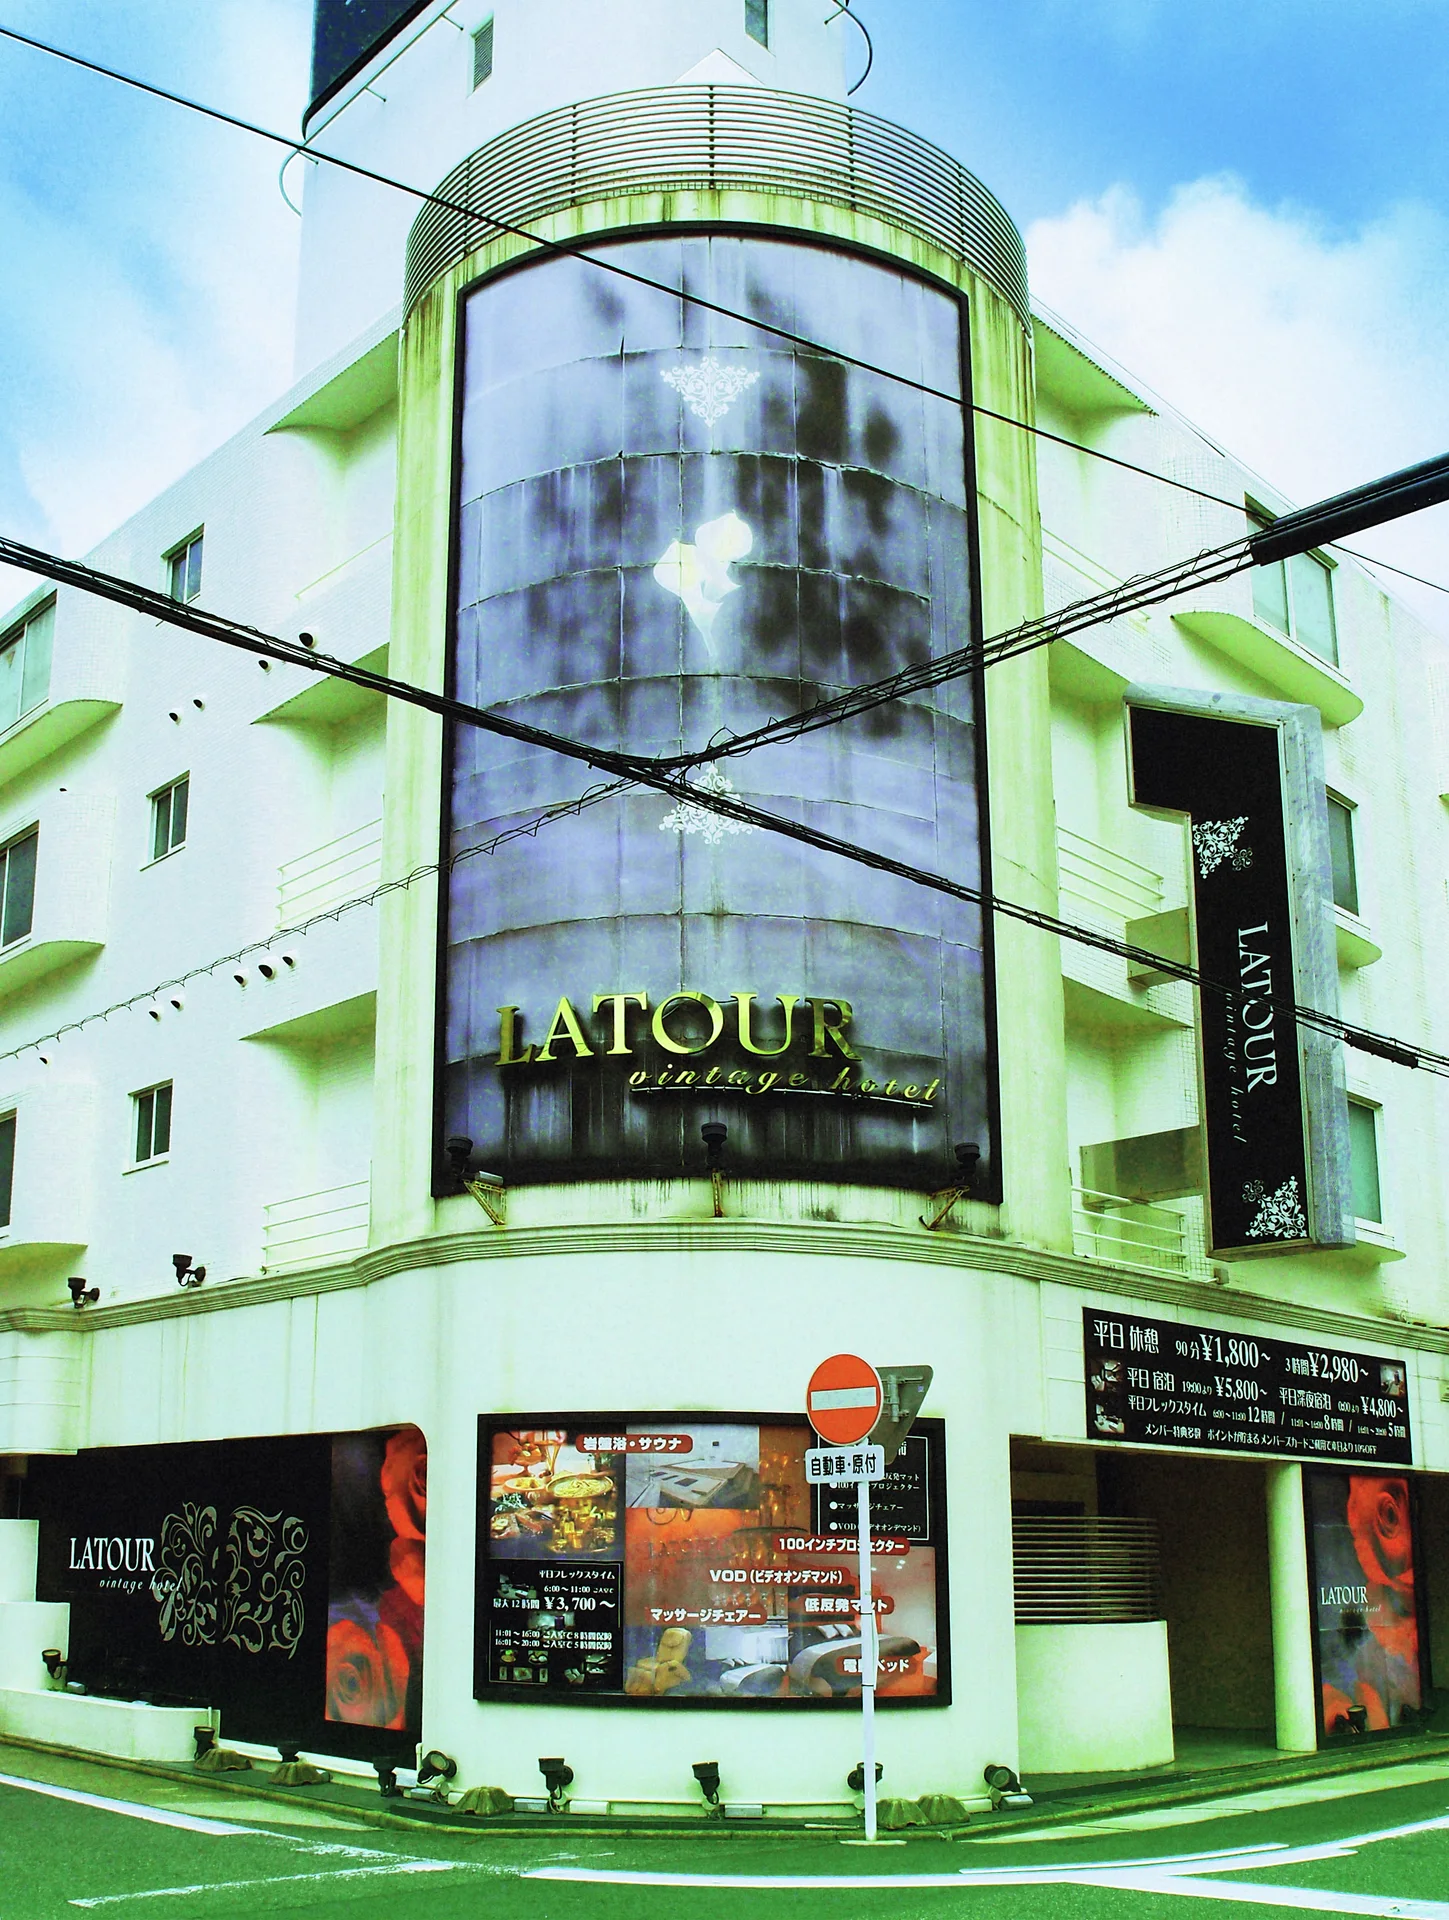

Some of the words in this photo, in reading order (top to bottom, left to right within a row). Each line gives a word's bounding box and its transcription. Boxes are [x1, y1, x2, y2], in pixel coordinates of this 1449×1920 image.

[1237, 921, 1278, 1093] LATOUR
[494, 991, 863, 1066] LATOUR
[1223, 992, 1238, 1073] vintage
[628, 1063, 809, 1095] vintage
[828, 1066, 940, 1101] hotel
[1230, 1086, 1247, 1143] hotel
[1093, 1319, 1125, 1350] 平日
[1129, 1325, 1160, 1354] 休憩
[1127, 1367, 1150, 1389] 平日
[1152, 1370, 1175, 1392] 宿泊
[1127, 1394, 1207, 1418] 平日フレックスタイム
[69, 1537, 156, 1572] LATOUR
[779, 1538, 905, 1553] 100インチプロェクター
[148, 1575, 183, 1592] hotel
[709, 1569, 748, 1583] VOD
[805, 1597, 888, 1613] 低反発マト
[1320, 1586, 1369, 1605] LATOUR
[650, 1608, 762, 1623] マッサージチェアー
[843, 1658, 909, 1673] 電ベッド
